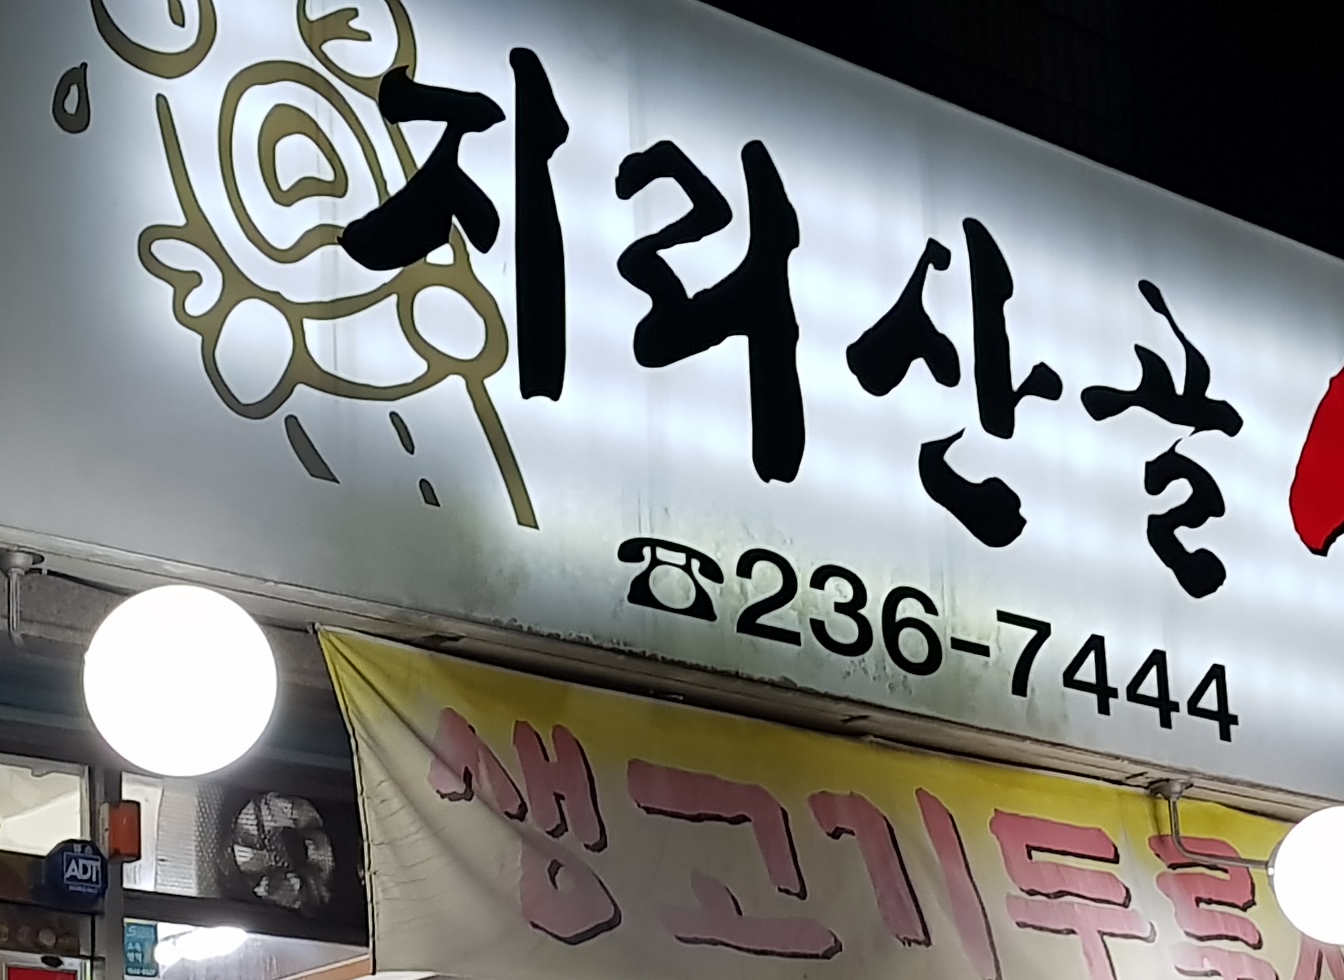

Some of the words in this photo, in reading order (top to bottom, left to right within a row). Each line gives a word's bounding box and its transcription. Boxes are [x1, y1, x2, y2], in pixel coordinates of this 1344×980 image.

[337, 46, 1244, 599] 지리산골
[735, 546, 1239, 743] 236-7444
[64, 857, 100, 883] ADT
